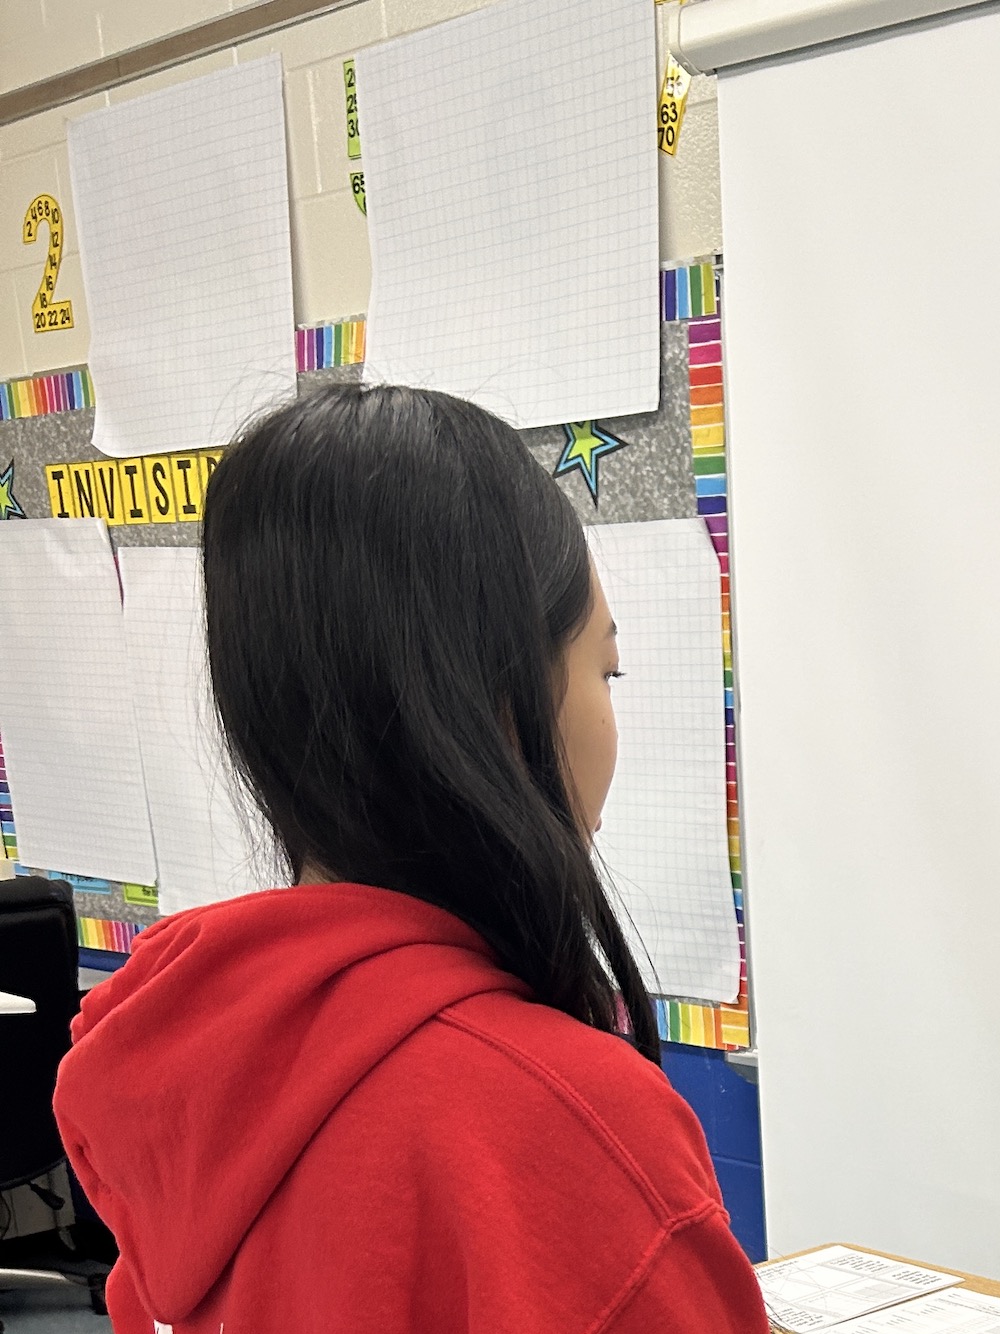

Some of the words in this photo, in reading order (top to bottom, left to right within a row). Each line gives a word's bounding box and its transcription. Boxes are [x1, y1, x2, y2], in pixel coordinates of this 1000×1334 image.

[660, 101, 678, 125] 63
[657, 125, 675, 148] 70
[30, 206, 38, 223] 4
[37, 200, 43, 216] 6
[44, 200, 50, 216] 8
[51, 207, 59, 224] 10
[26, 221, 33, 237] 2
[51, 231, 60, 248] 12
[49, 253, 58, 270] 14
[45, 275, 54, 292] 16
[39, 292, 48, 309] 18
[34, 312, 47, 329] 20
[47, 310, 59, 327] 22
[59, 307, 71, 325] 24
